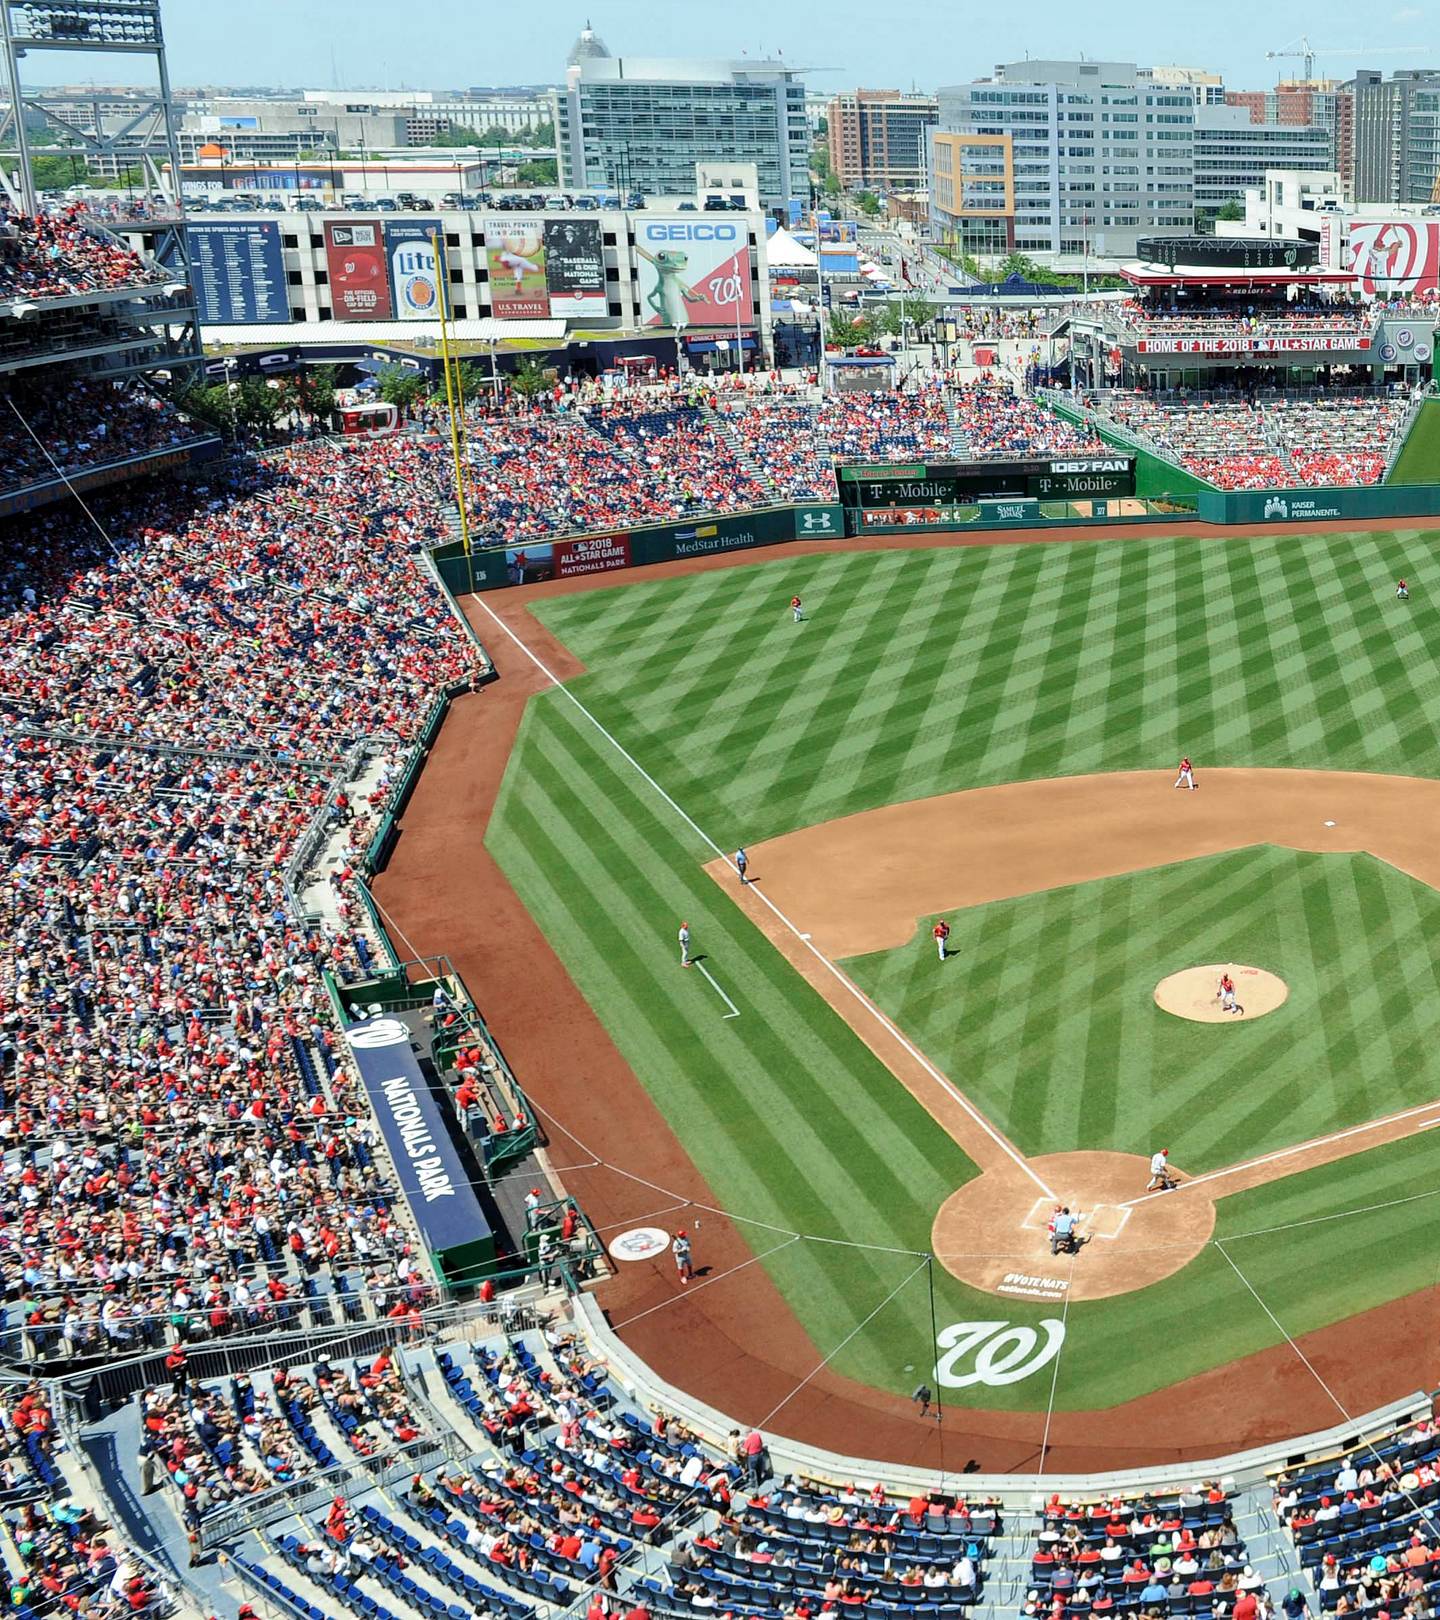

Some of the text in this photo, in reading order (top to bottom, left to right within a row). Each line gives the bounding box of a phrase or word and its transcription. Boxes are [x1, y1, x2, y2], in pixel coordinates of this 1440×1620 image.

[646, 224, 736, 241] GEICO
[399, 253, 436, 275] Lite
[1145, 338, 1361, 353] HOME OF THE 2018 ALL STAR GAME
[1092, 460, 1129, 472] FAN
[997, 504, 1026, 514] SAMUEL
[1291, 501, 1315, 509] KAISER
[1000, 511, 1023, 519] ADAMS
[1291, 508, 1338, 518] PERMANENTE
[590, 538, 613, 550] 2018
[676, 532, 754, 554] MedStar Health
[561, 546, 625, 564] ALL STAR GAME
[561, 558, 626, 575] NATIONALS PARK
[380, 1076, 454, 1202] NATIONALS PARK
[997, 1285, 1062, 1298] nationals.com
[932, 1318, 1066, 1388] W
